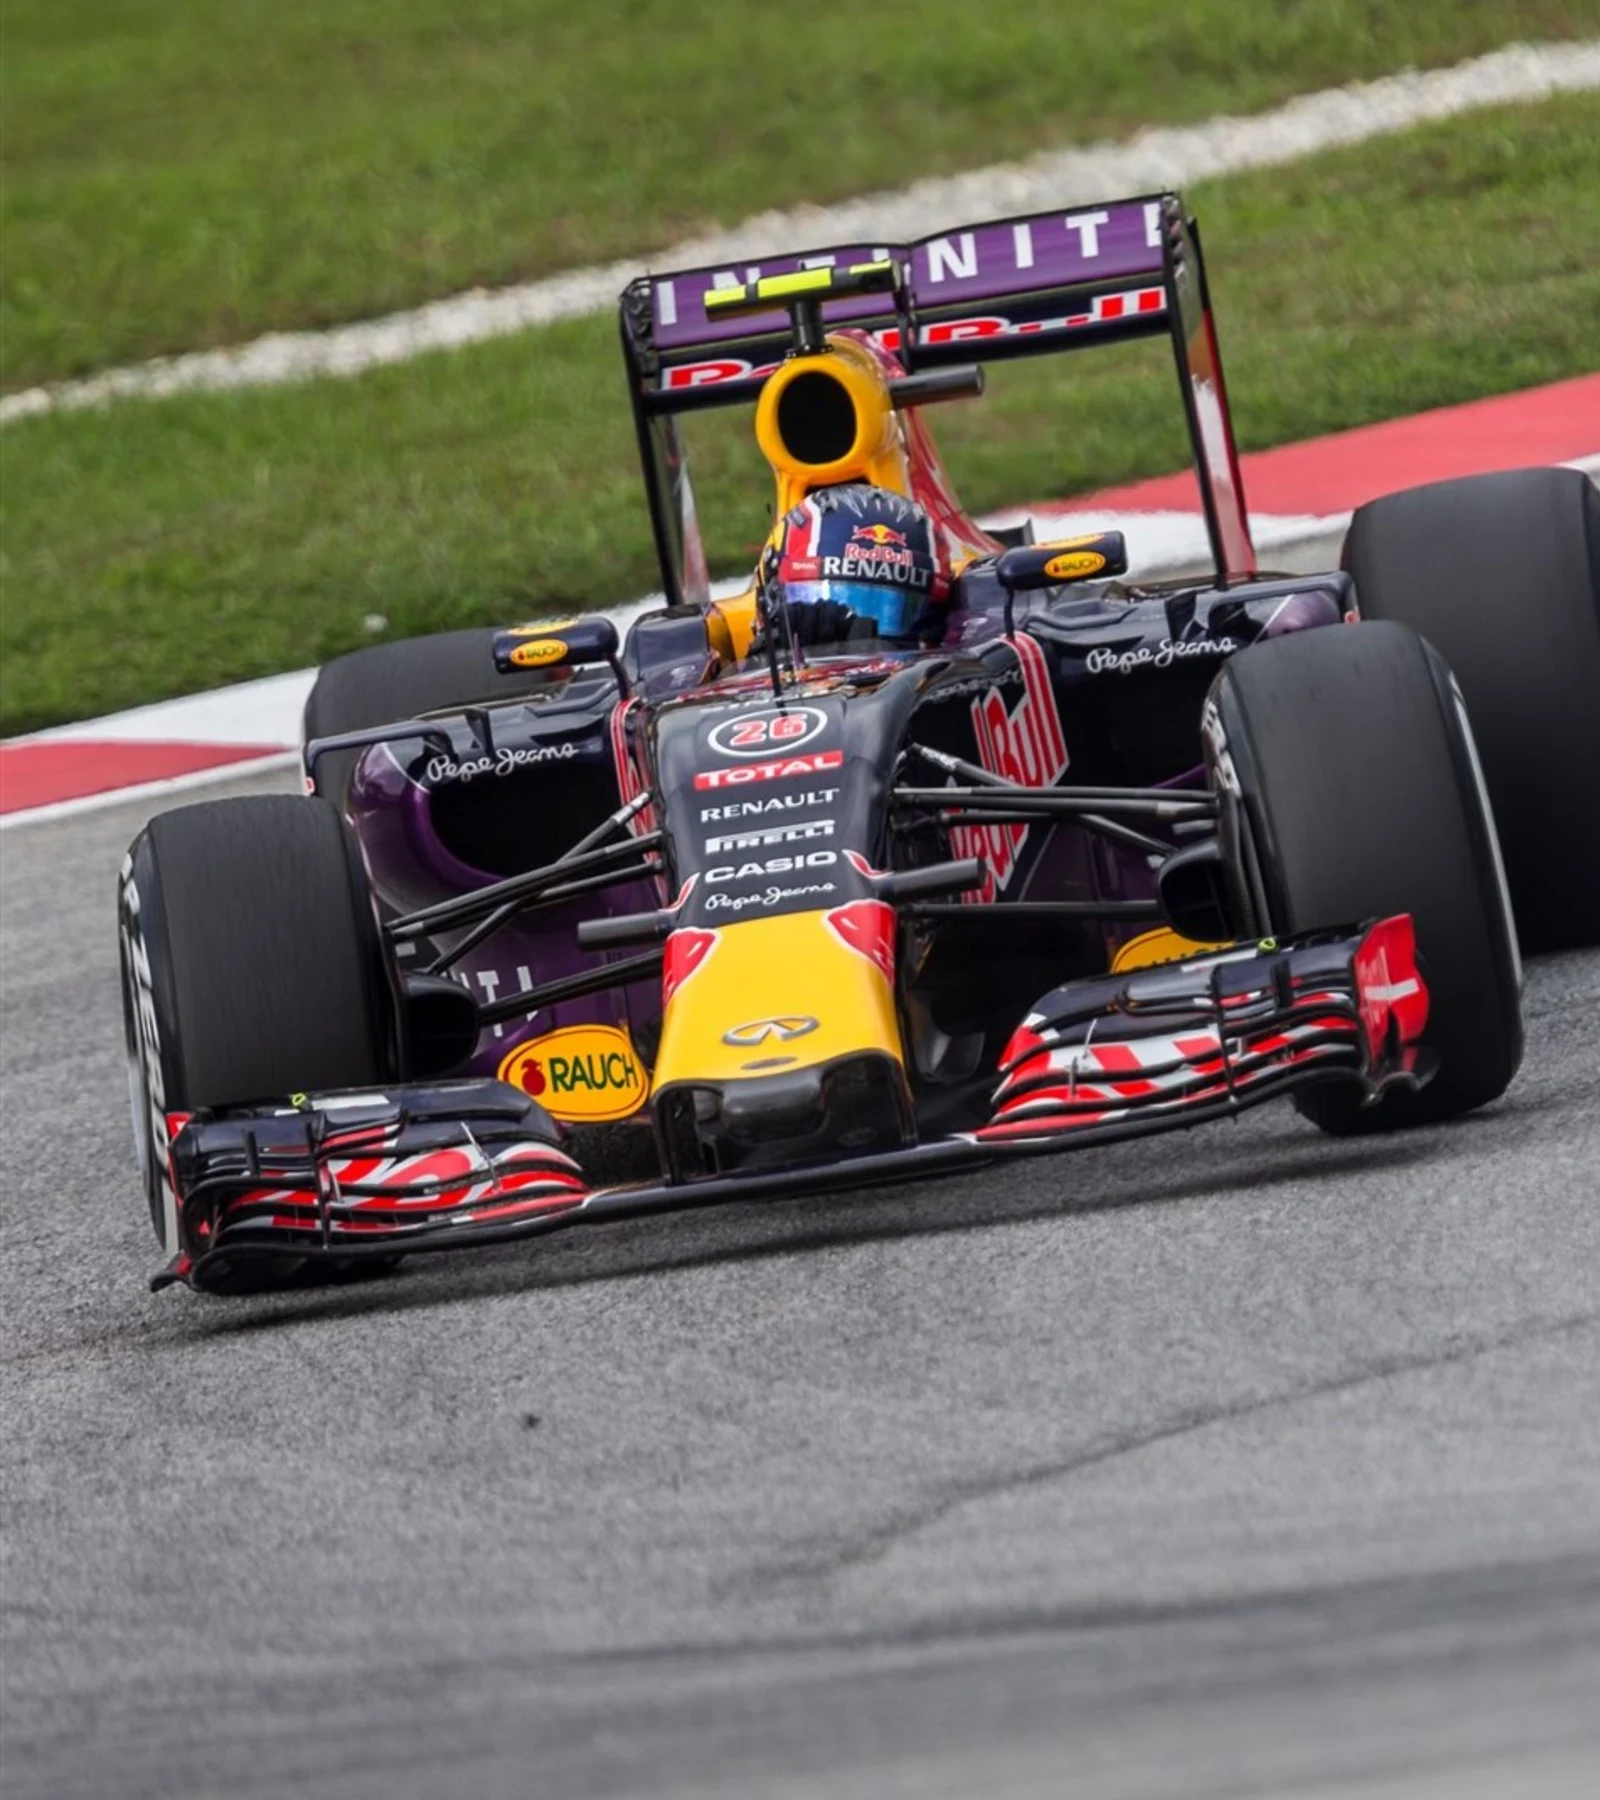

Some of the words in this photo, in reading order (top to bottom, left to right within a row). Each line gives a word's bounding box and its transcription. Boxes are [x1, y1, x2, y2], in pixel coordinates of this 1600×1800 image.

[823, 556, 932, 587] RENAULT
[844, 542, 879, 561] Red
[879, 544, 914, 567] Bull
[1085, 647, 1154, 674] Pepe
[1154, 637, 1237, 668] Jeans
[729, 713, 808, 747] 26
[427, 755, 494, 783] Pepe
[495, 743, 580, 776] Jeans
[706, 755, 840, 788] TOTAL
[701, 788, 840, 823] RENAULT
[704, 819, 836, 855] PIRELLI
[704, 851, 838, 883] CASIO
[705, 893, 763, 910] Pepe
[762, 882, 838, 906] Jeans
[548, 1051, 639, 1093] RAUCH
